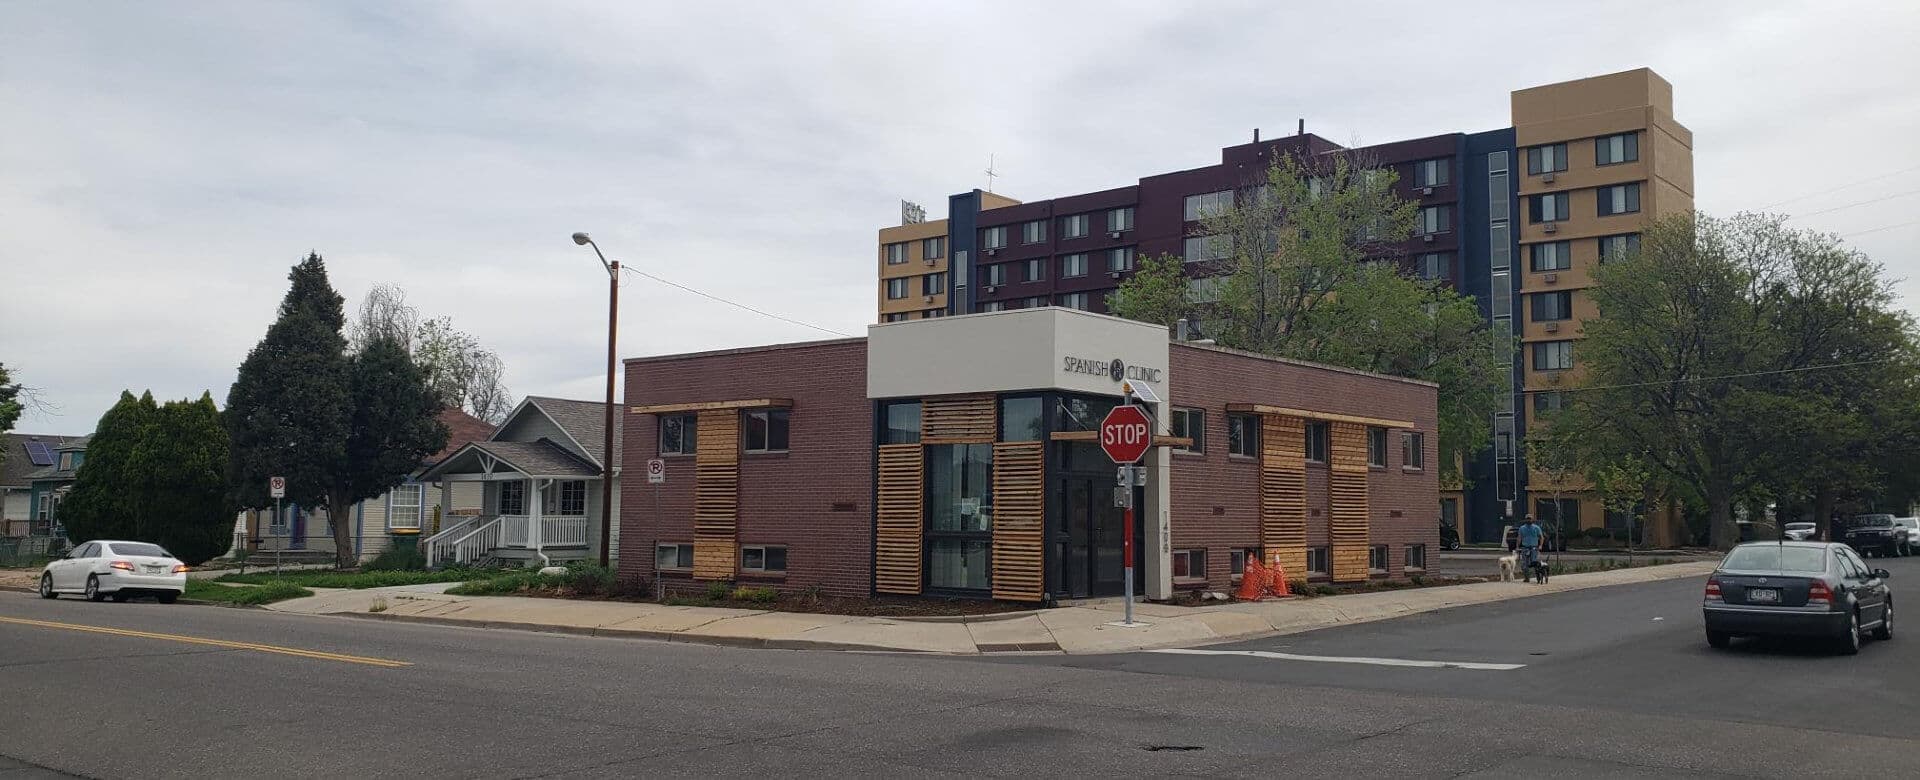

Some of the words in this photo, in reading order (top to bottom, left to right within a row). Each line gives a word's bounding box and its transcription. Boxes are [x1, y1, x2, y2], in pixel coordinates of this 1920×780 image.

[1064, 356, 1109, 376] SPANISH
[1127, 365, 1161, 383] CLINIC
[1105, 424, 1147, 445] STOP
